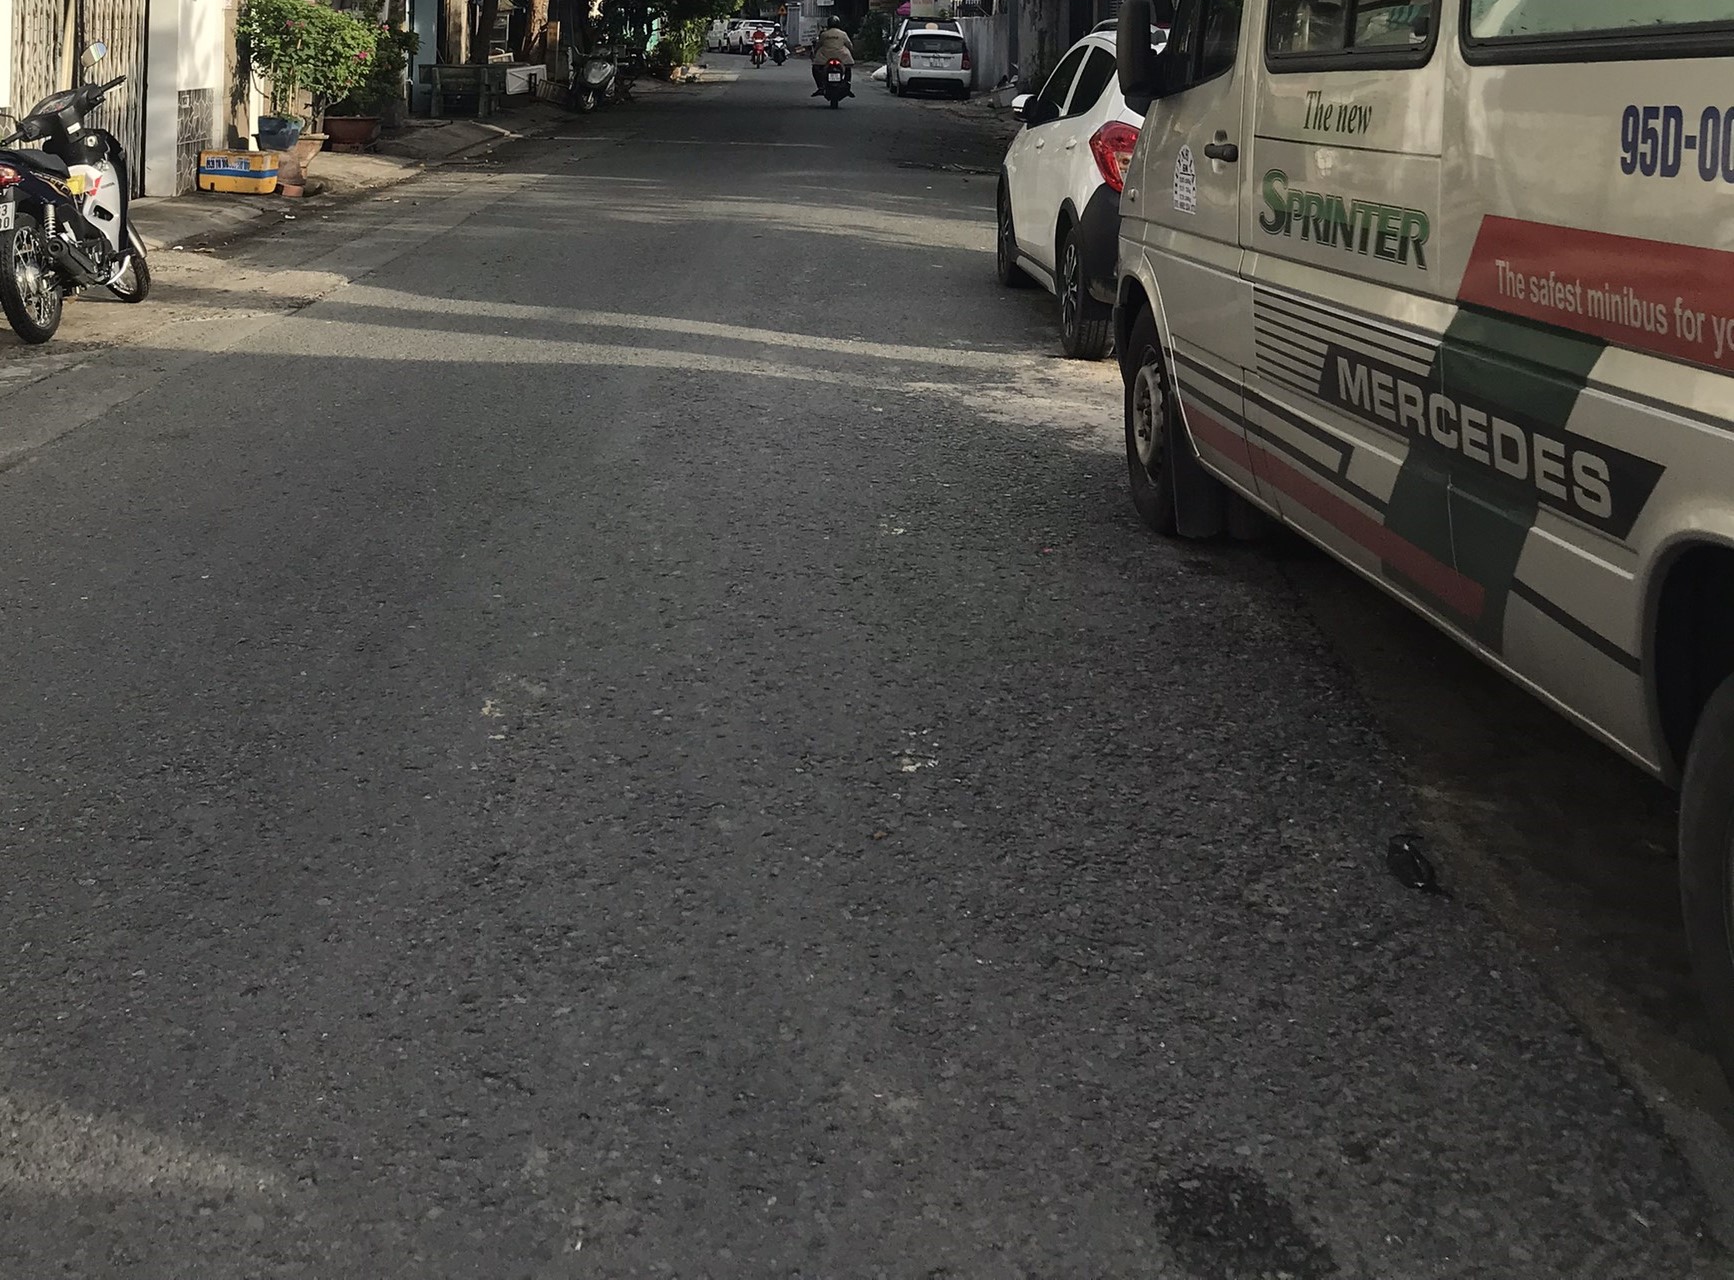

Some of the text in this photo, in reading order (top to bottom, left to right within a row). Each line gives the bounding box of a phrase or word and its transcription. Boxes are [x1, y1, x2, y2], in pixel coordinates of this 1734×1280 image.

[1304, 90, 1373, 134] The new
[1259, 169, 1431, 271] SPRINTER
[1495, 259, 1525, 300] The
[1530, 271, 1582, 314] safest
[1587, 282, 1668, 335] minibus
[1674, 296, 1705, 343] for
[1337, 356, 1612, 519] MERCEDES
